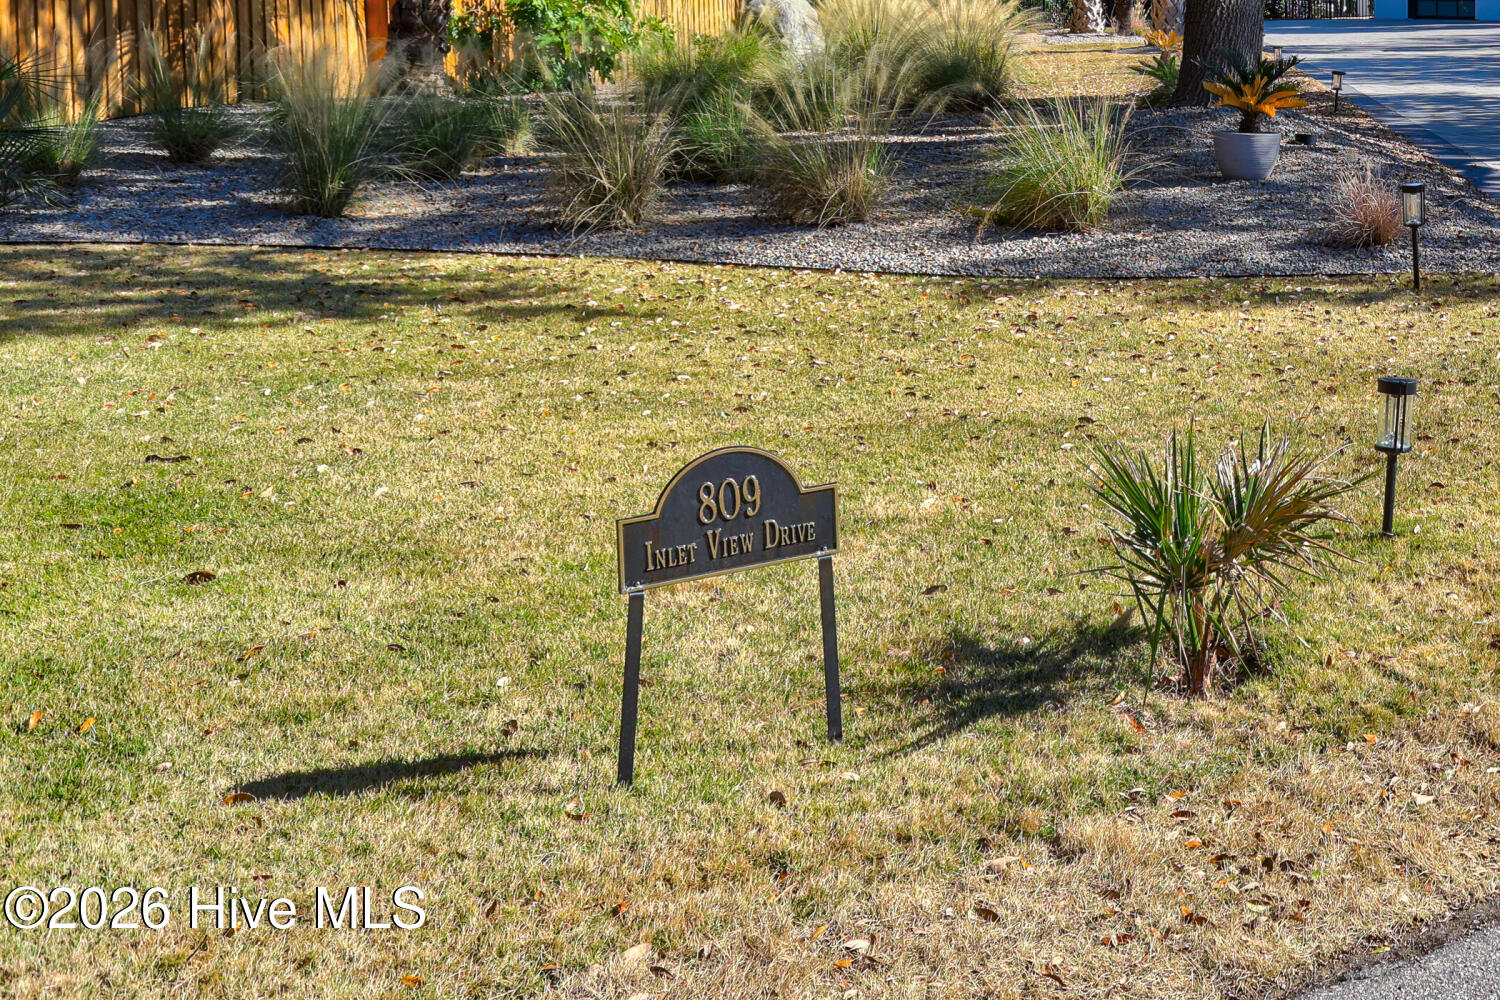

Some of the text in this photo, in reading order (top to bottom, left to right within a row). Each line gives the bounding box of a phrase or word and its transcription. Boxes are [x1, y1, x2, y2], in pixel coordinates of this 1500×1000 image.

[698, 474, 761, 525] 809
[644, 518, 816, 572] INLET VIEW DRIVE
